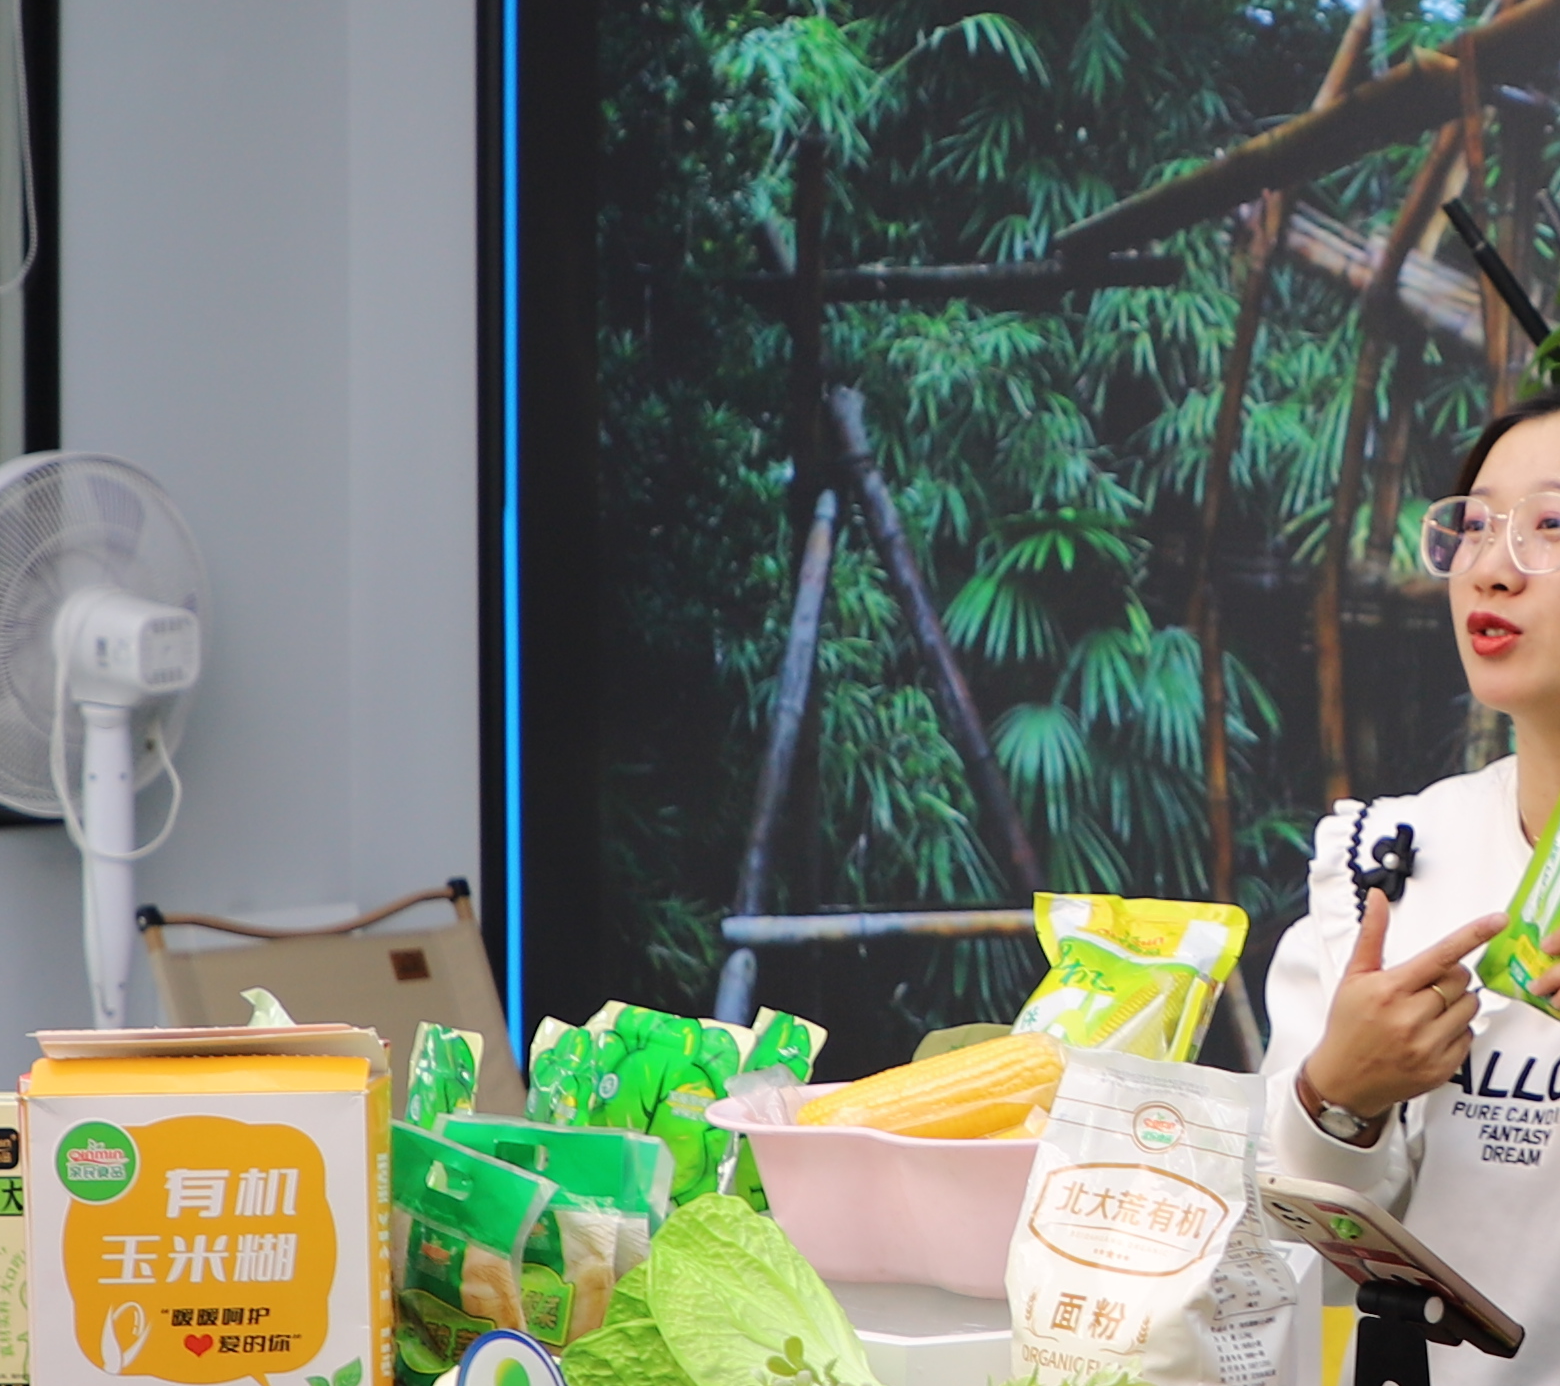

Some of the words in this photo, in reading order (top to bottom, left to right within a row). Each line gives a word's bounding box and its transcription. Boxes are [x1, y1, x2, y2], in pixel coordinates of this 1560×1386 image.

[1452, 1101, 1503, 1122] PURE
[1478, 1124, 1552, 1147] FANTASY
[1481, 1144, 1542, 1167] DREAM
[164, 1167, 300, 1219] 有机
[1055, 1180, 1209, 1240] 北大荒有机
[98, 1233, 298, 1284] 玉米糊
[1050, 1292, 1127, 1341] 面粉
